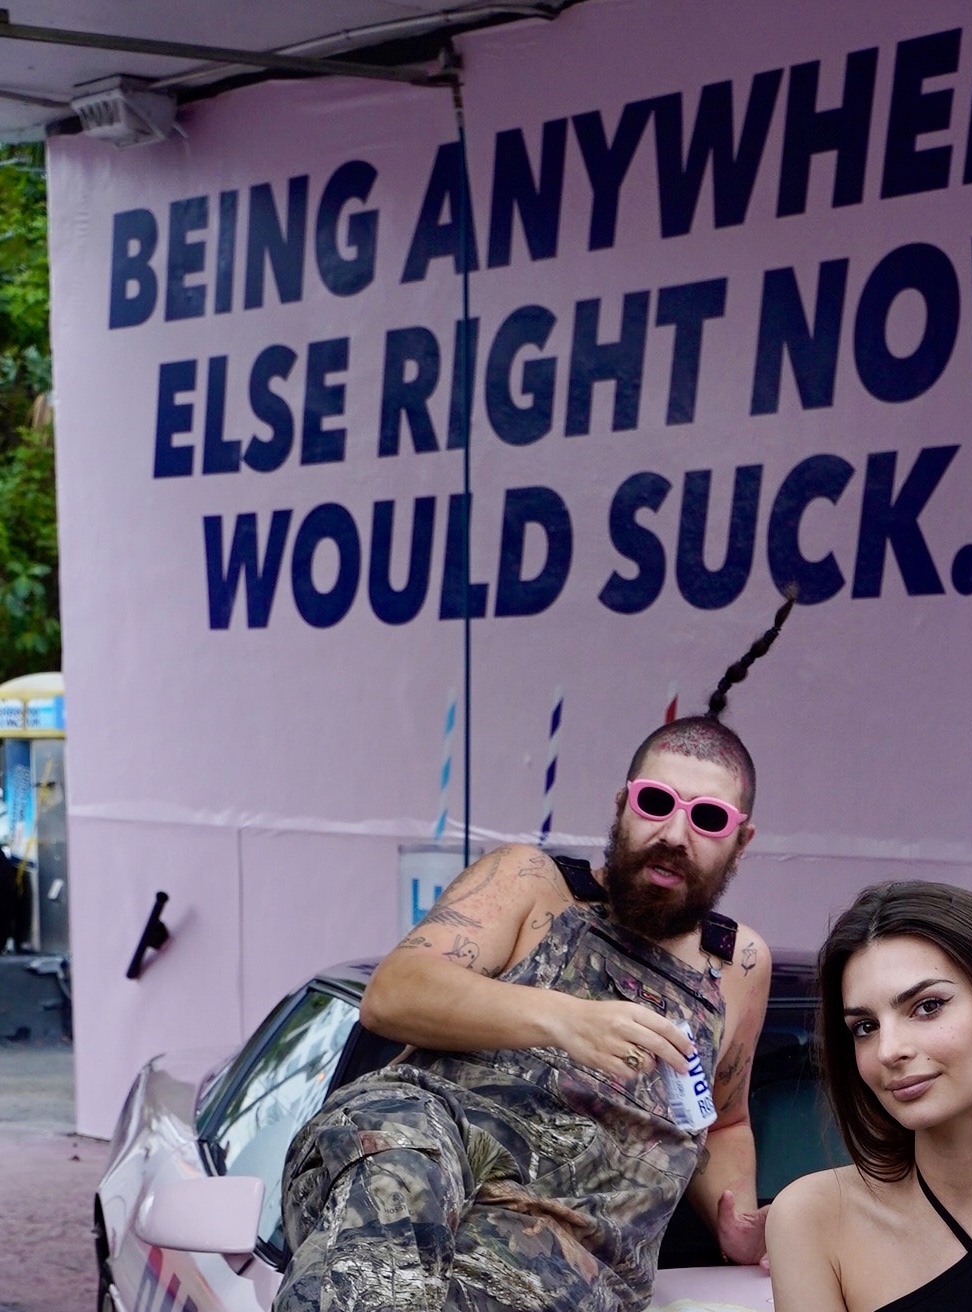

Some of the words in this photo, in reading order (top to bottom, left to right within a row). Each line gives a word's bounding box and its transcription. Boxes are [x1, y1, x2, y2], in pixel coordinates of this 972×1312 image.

[108, 160, 379, 330] BEING
[153, 337, 349, 478] ELSE
[378, 277, 728, 458] RIGHT
[203, 485, 573, 630] WOULD
